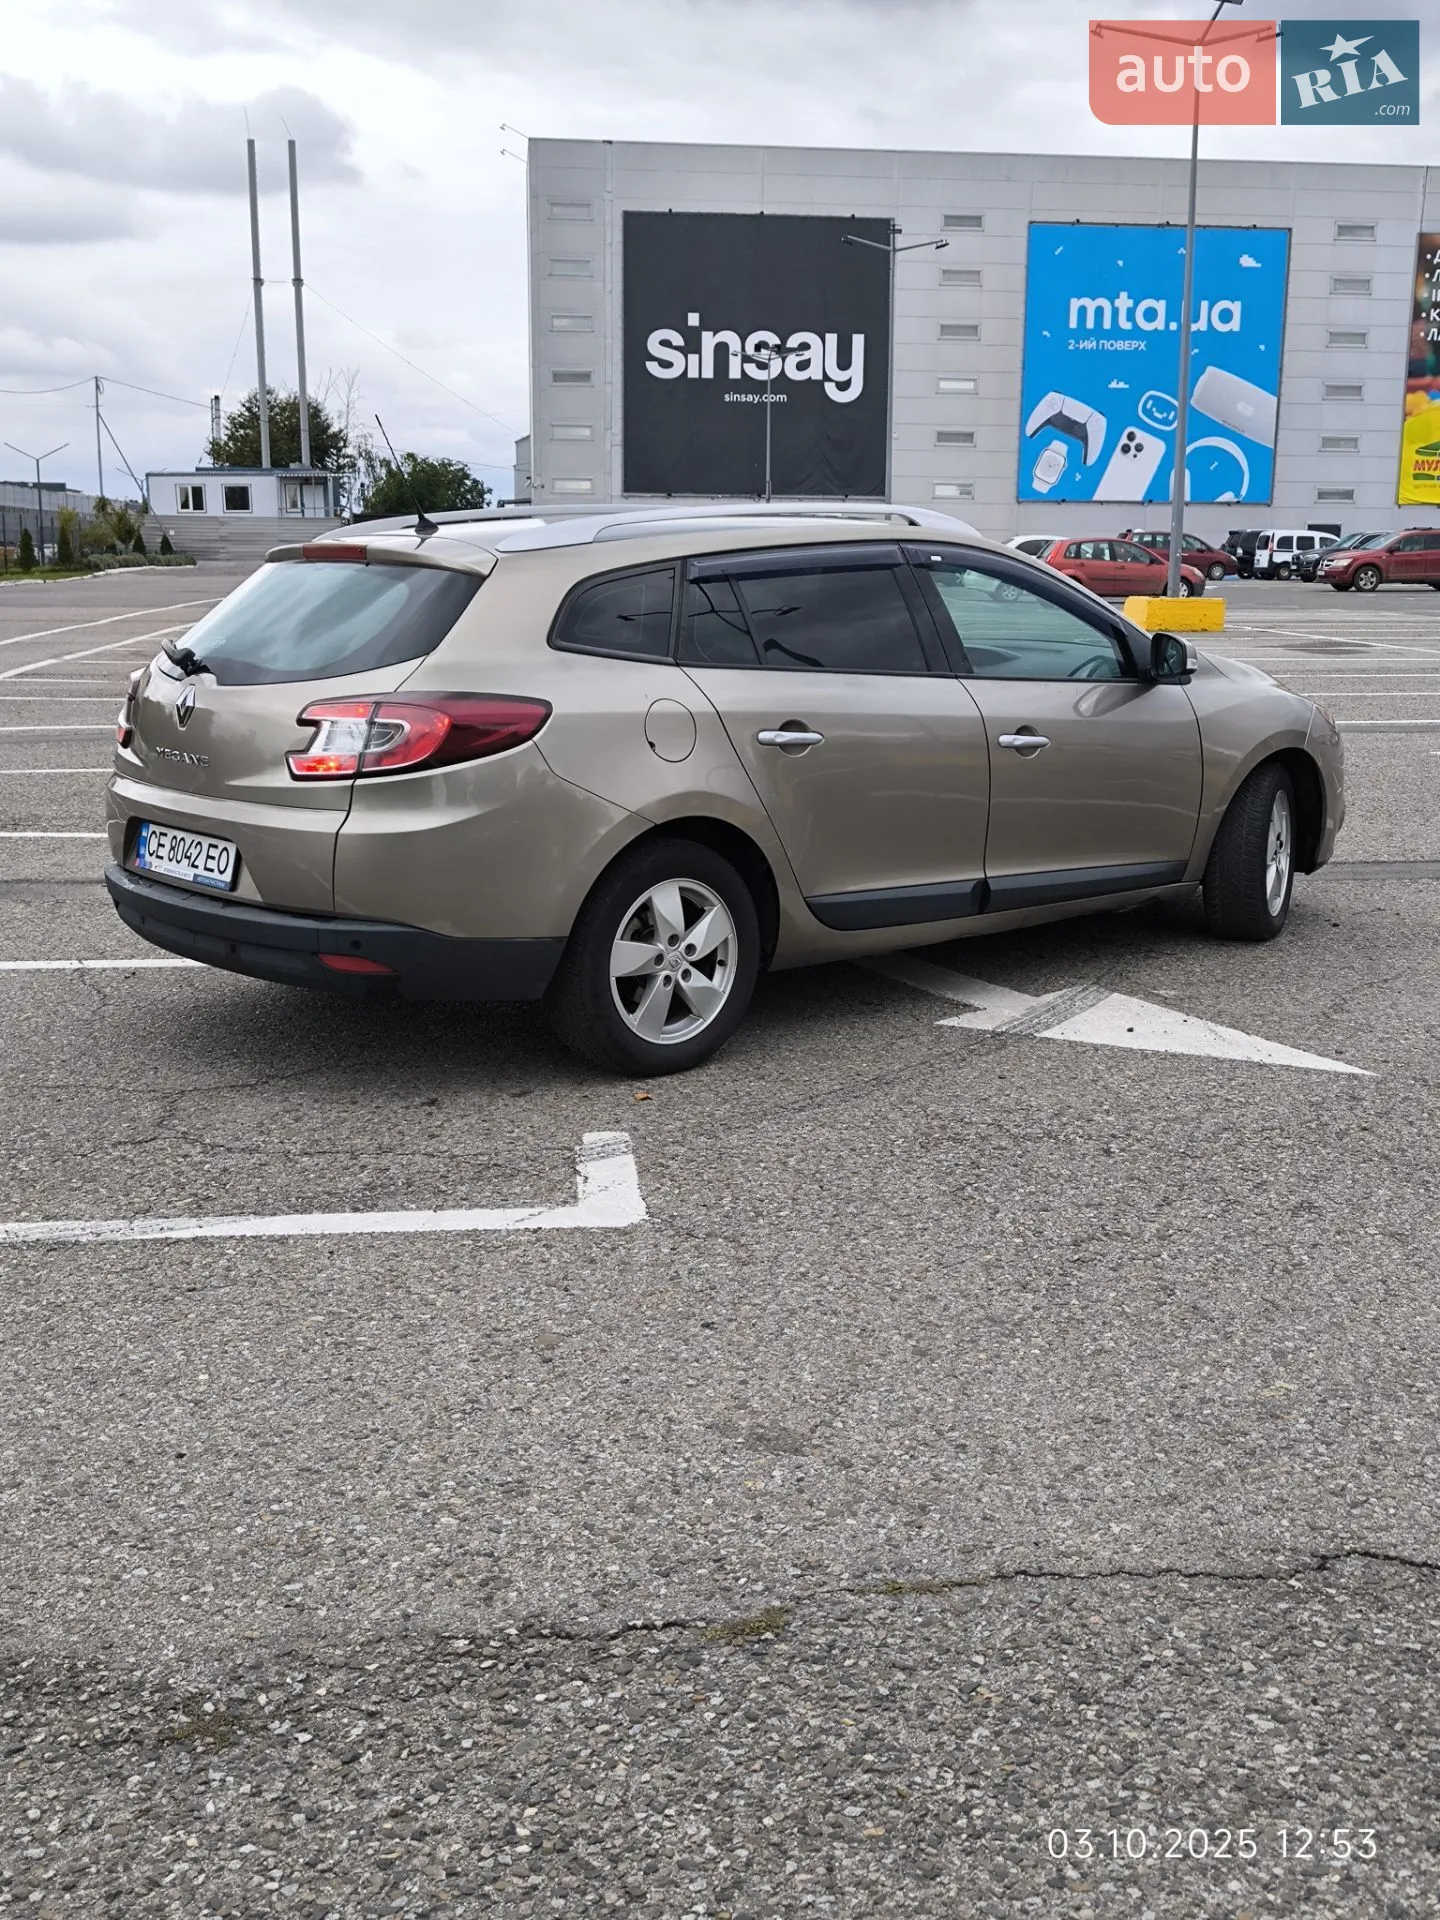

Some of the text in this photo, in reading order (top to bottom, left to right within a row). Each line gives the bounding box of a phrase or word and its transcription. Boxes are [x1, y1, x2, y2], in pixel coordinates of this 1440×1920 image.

[1068, 291, 1242, 332] mta.ua
[645, 312, 865, 403] sinsay
[1068, 337, 1147, 351] 2-ИЙ ПОВЕРХ
[724, 391, 787, 403] sinsay.com
[155, 746, 210, 767] MEGANE
[147, 830, 167, 860] CE
[168, 835, 203, 869] 8042
[203, 843, 230, 875] EO
